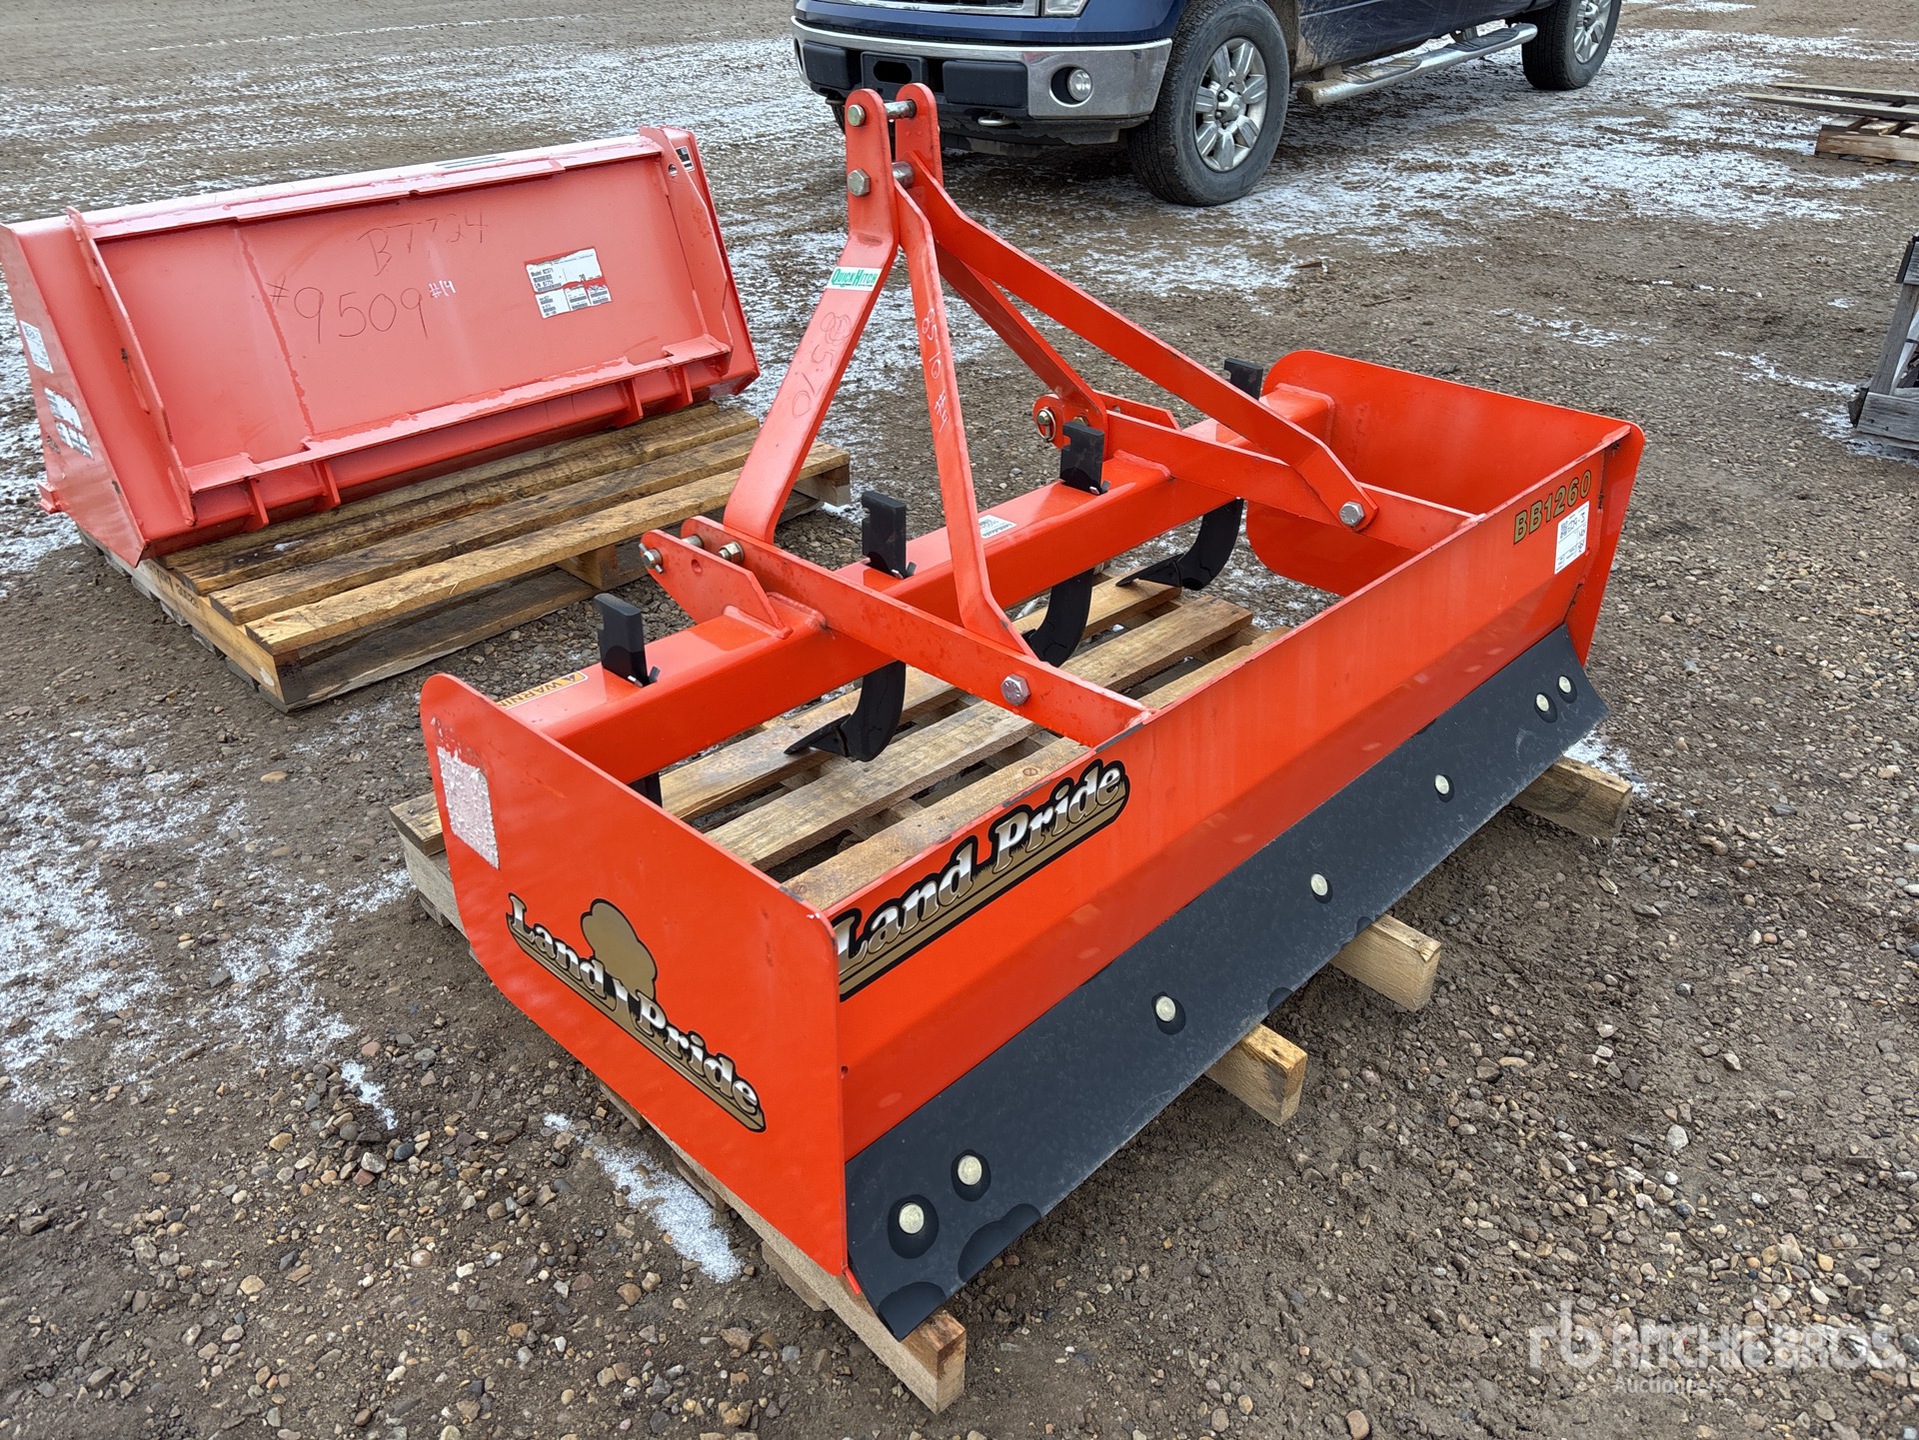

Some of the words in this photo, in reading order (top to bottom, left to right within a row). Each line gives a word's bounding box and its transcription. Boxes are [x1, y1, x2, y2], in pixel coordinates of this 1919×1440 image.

[1513, 469, 1591, 545] BB1260
[832, 842, 975, 975] Land
[992, 764, 1122, 874] Pride
[507, 893, 608, 1000] Land
[634, 989, 759, 1115] Pride
